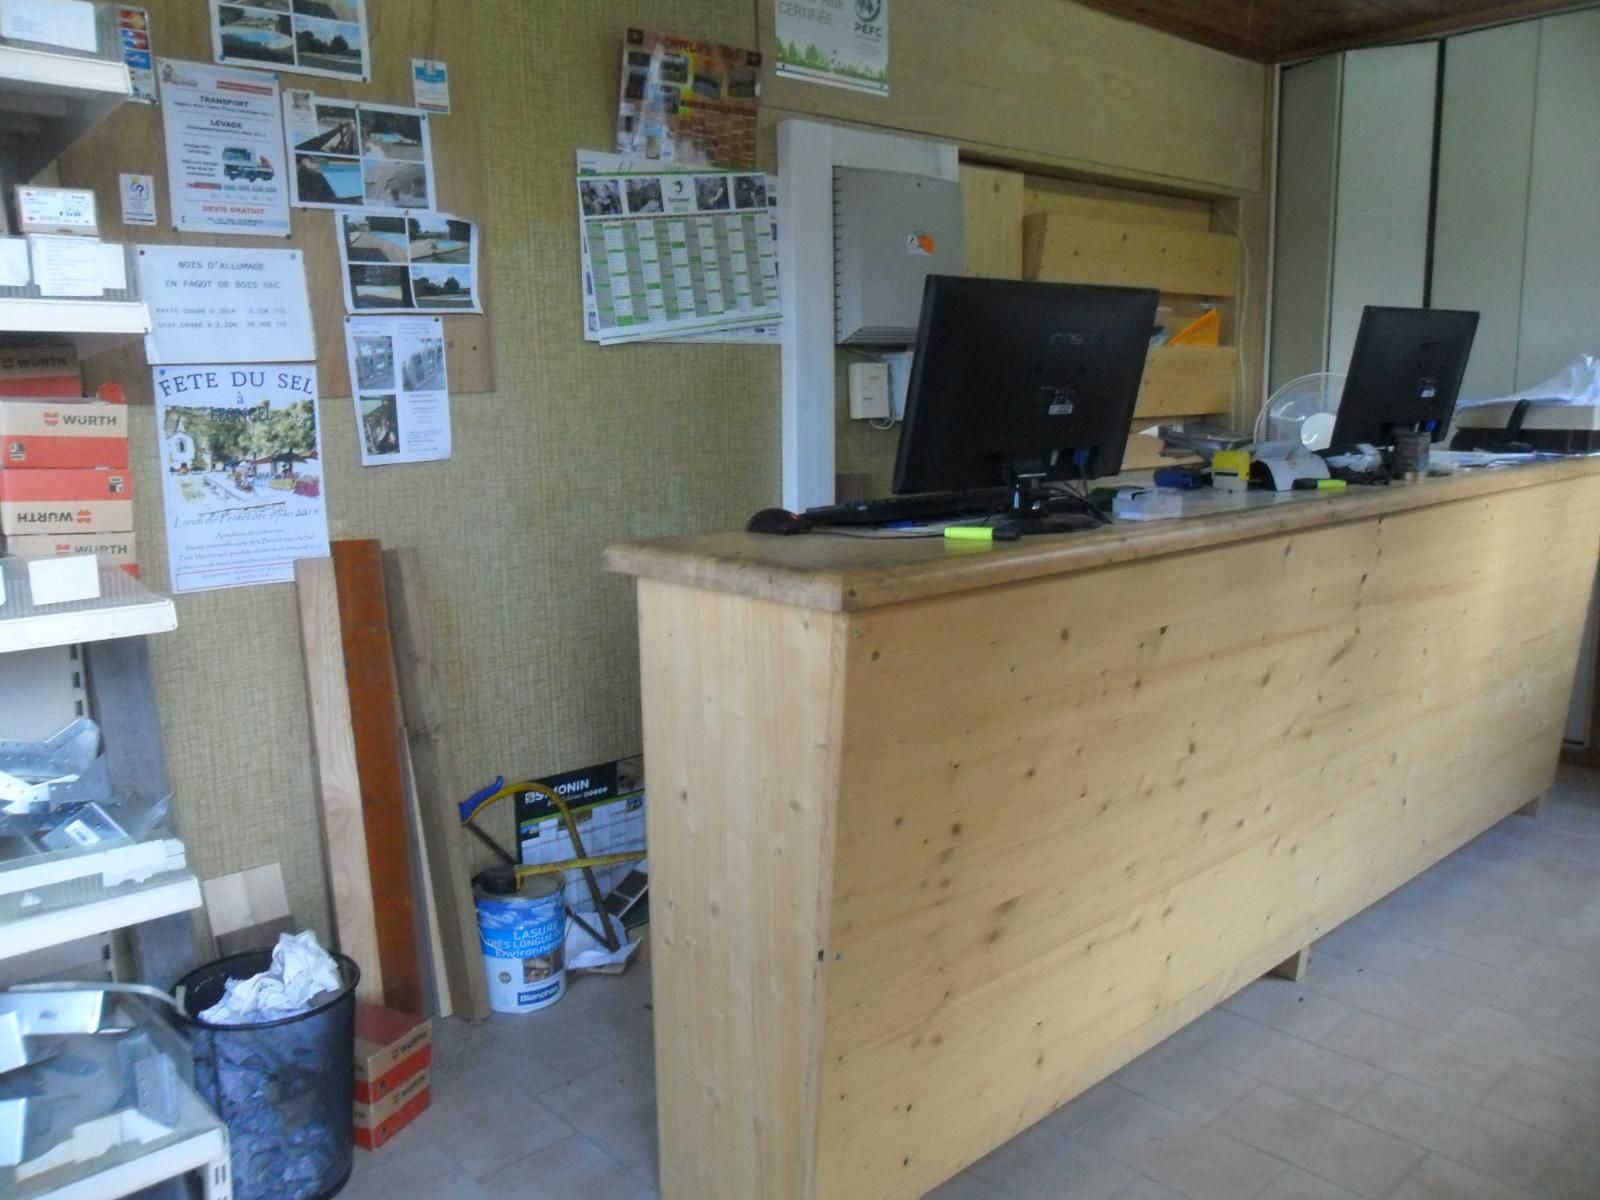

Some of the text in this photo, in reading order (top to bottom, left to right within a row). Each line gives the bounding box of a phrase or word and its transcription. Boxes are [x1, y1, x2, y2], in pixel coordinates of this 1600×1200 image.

[854, 22, 882, 38] PEFC
[200, 95, 248, 107] TRANSPORT
[210, 119, 242, 129] LEVAGE
[202, 205, 265, 215] DEVIS GRATUIT
[178, 261, 264, 271] BOIS D'ALLUMAGE
[165, 280, 280, 289] EN FAGOT DE BOIS SEC
[158, 371, 313, 397] FETE DU SEL
[236, 391, 244, 404] à
[62, 415, 117, 426] WÜRTH
[17, 512, 73, 523] WÜRTH
[513, 922, 558, 940] LASURE
[513, 932, 553, 949] LONGUE
